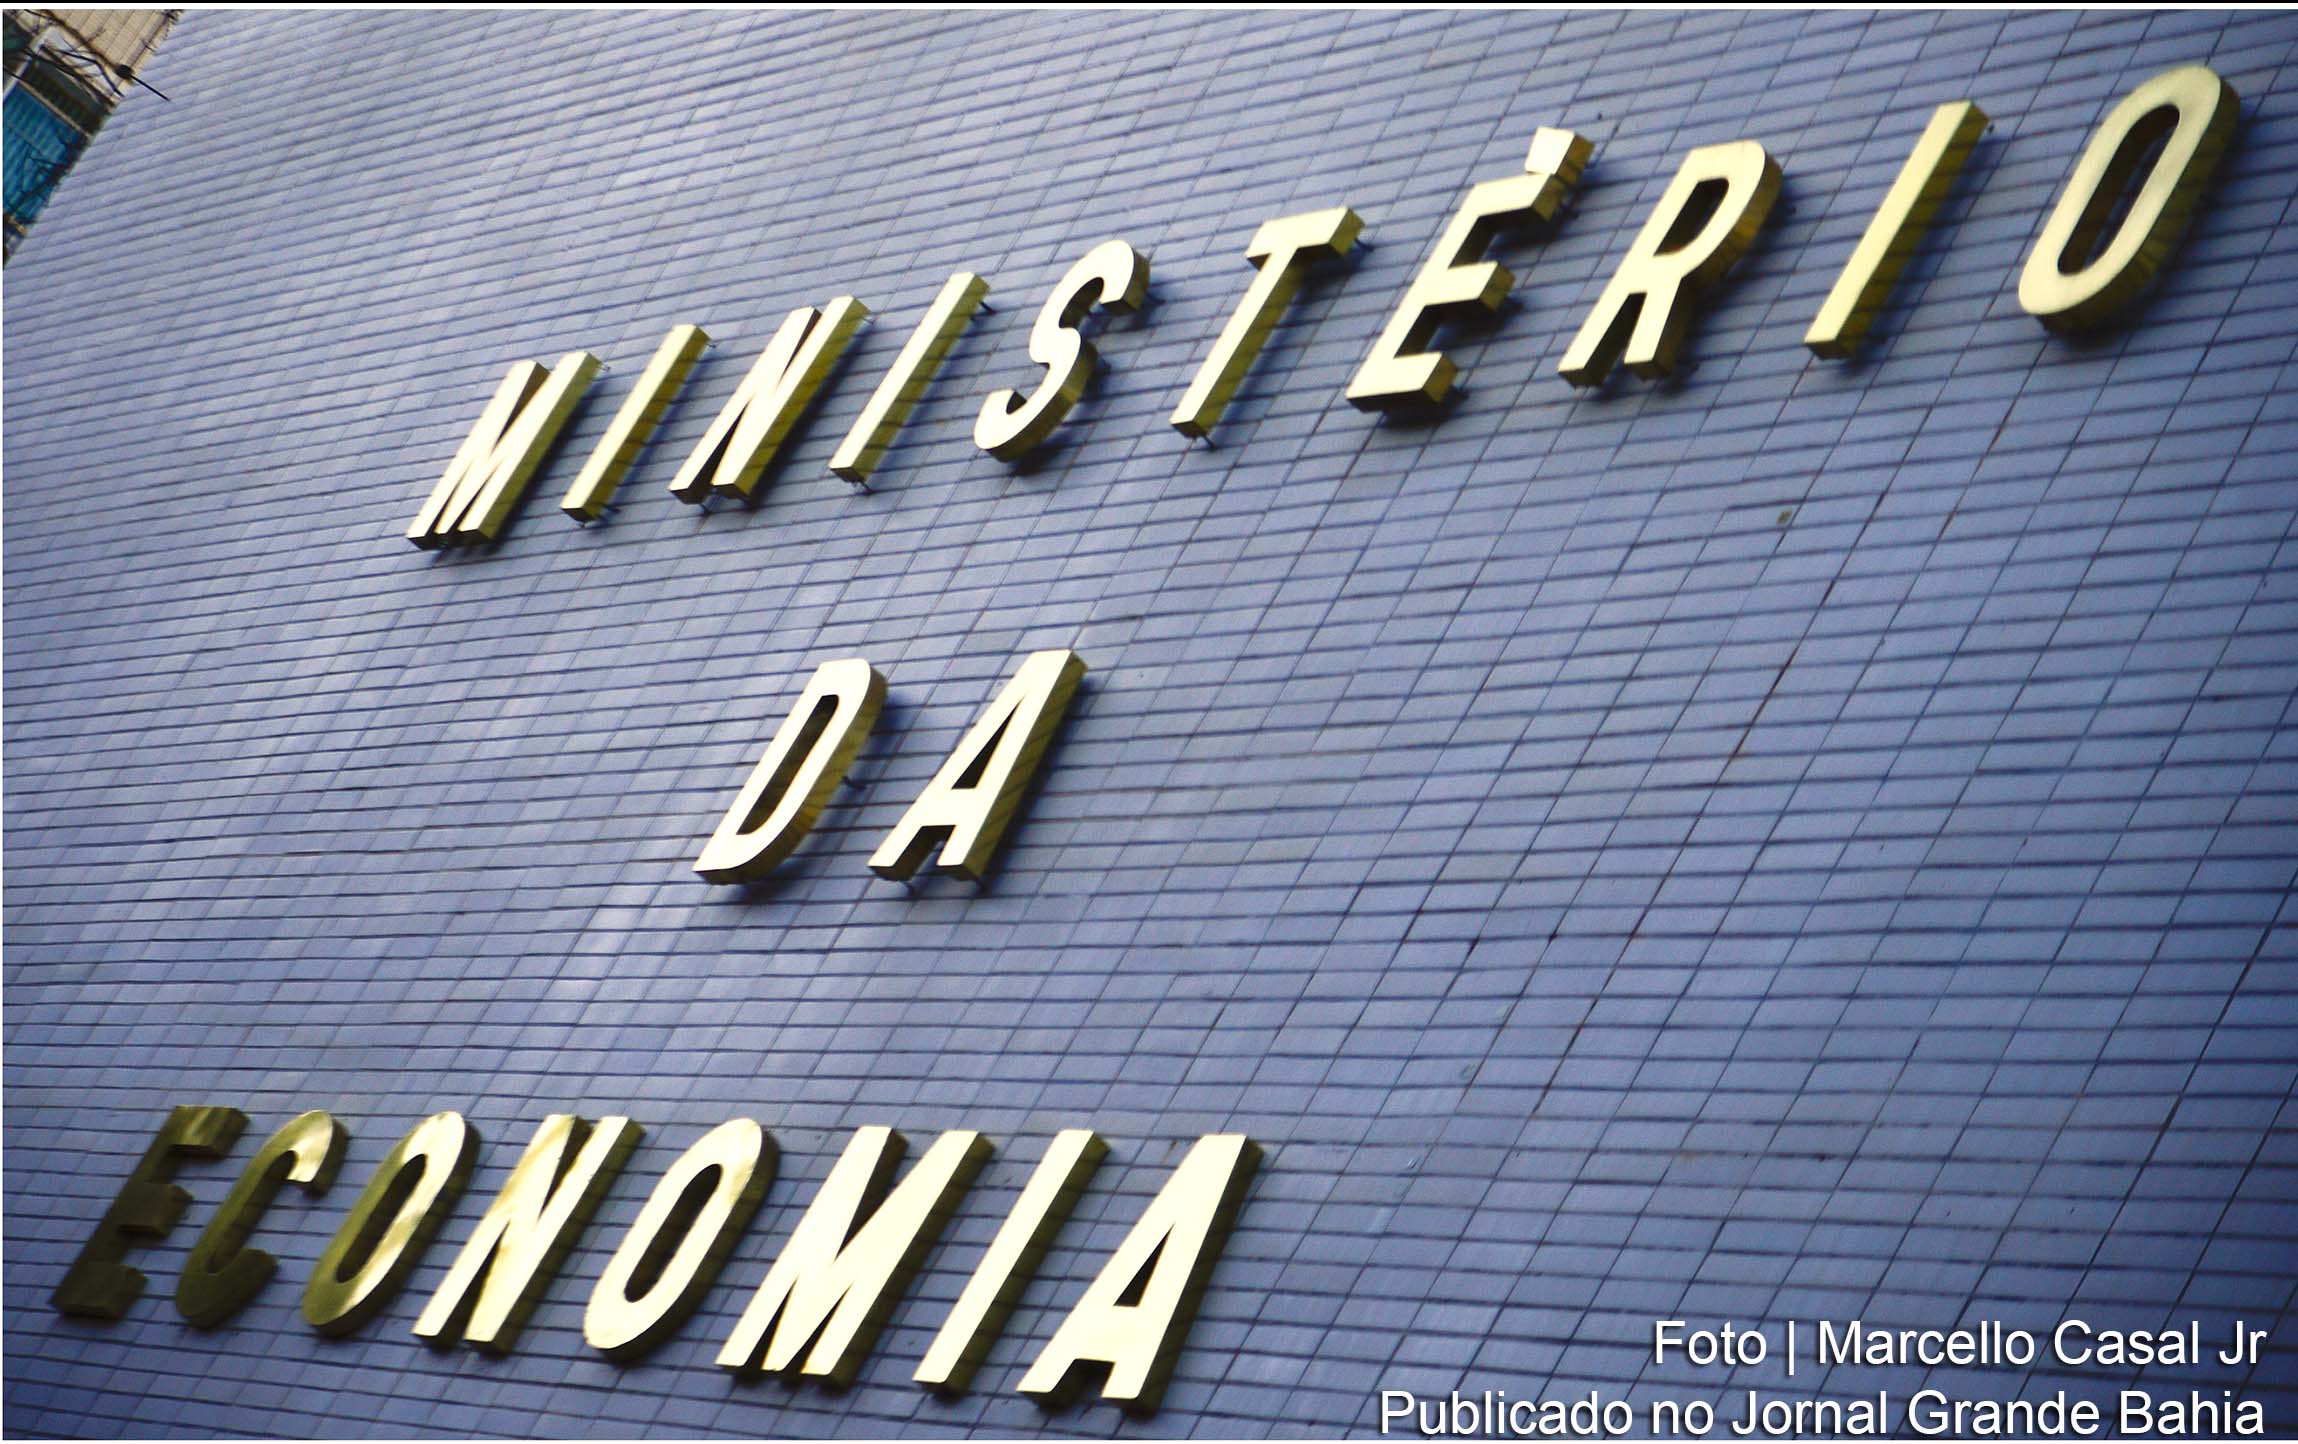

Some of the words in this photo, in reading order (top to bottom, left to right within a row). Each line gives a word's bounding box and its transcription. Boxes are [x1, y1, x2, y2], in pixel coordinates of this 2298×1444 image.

[407, 65, 2240, 551] MINISTÉRIO
[693, 649, 1088, 886] DA
[52, 1105, 1263, 1412] ECONOMIA
